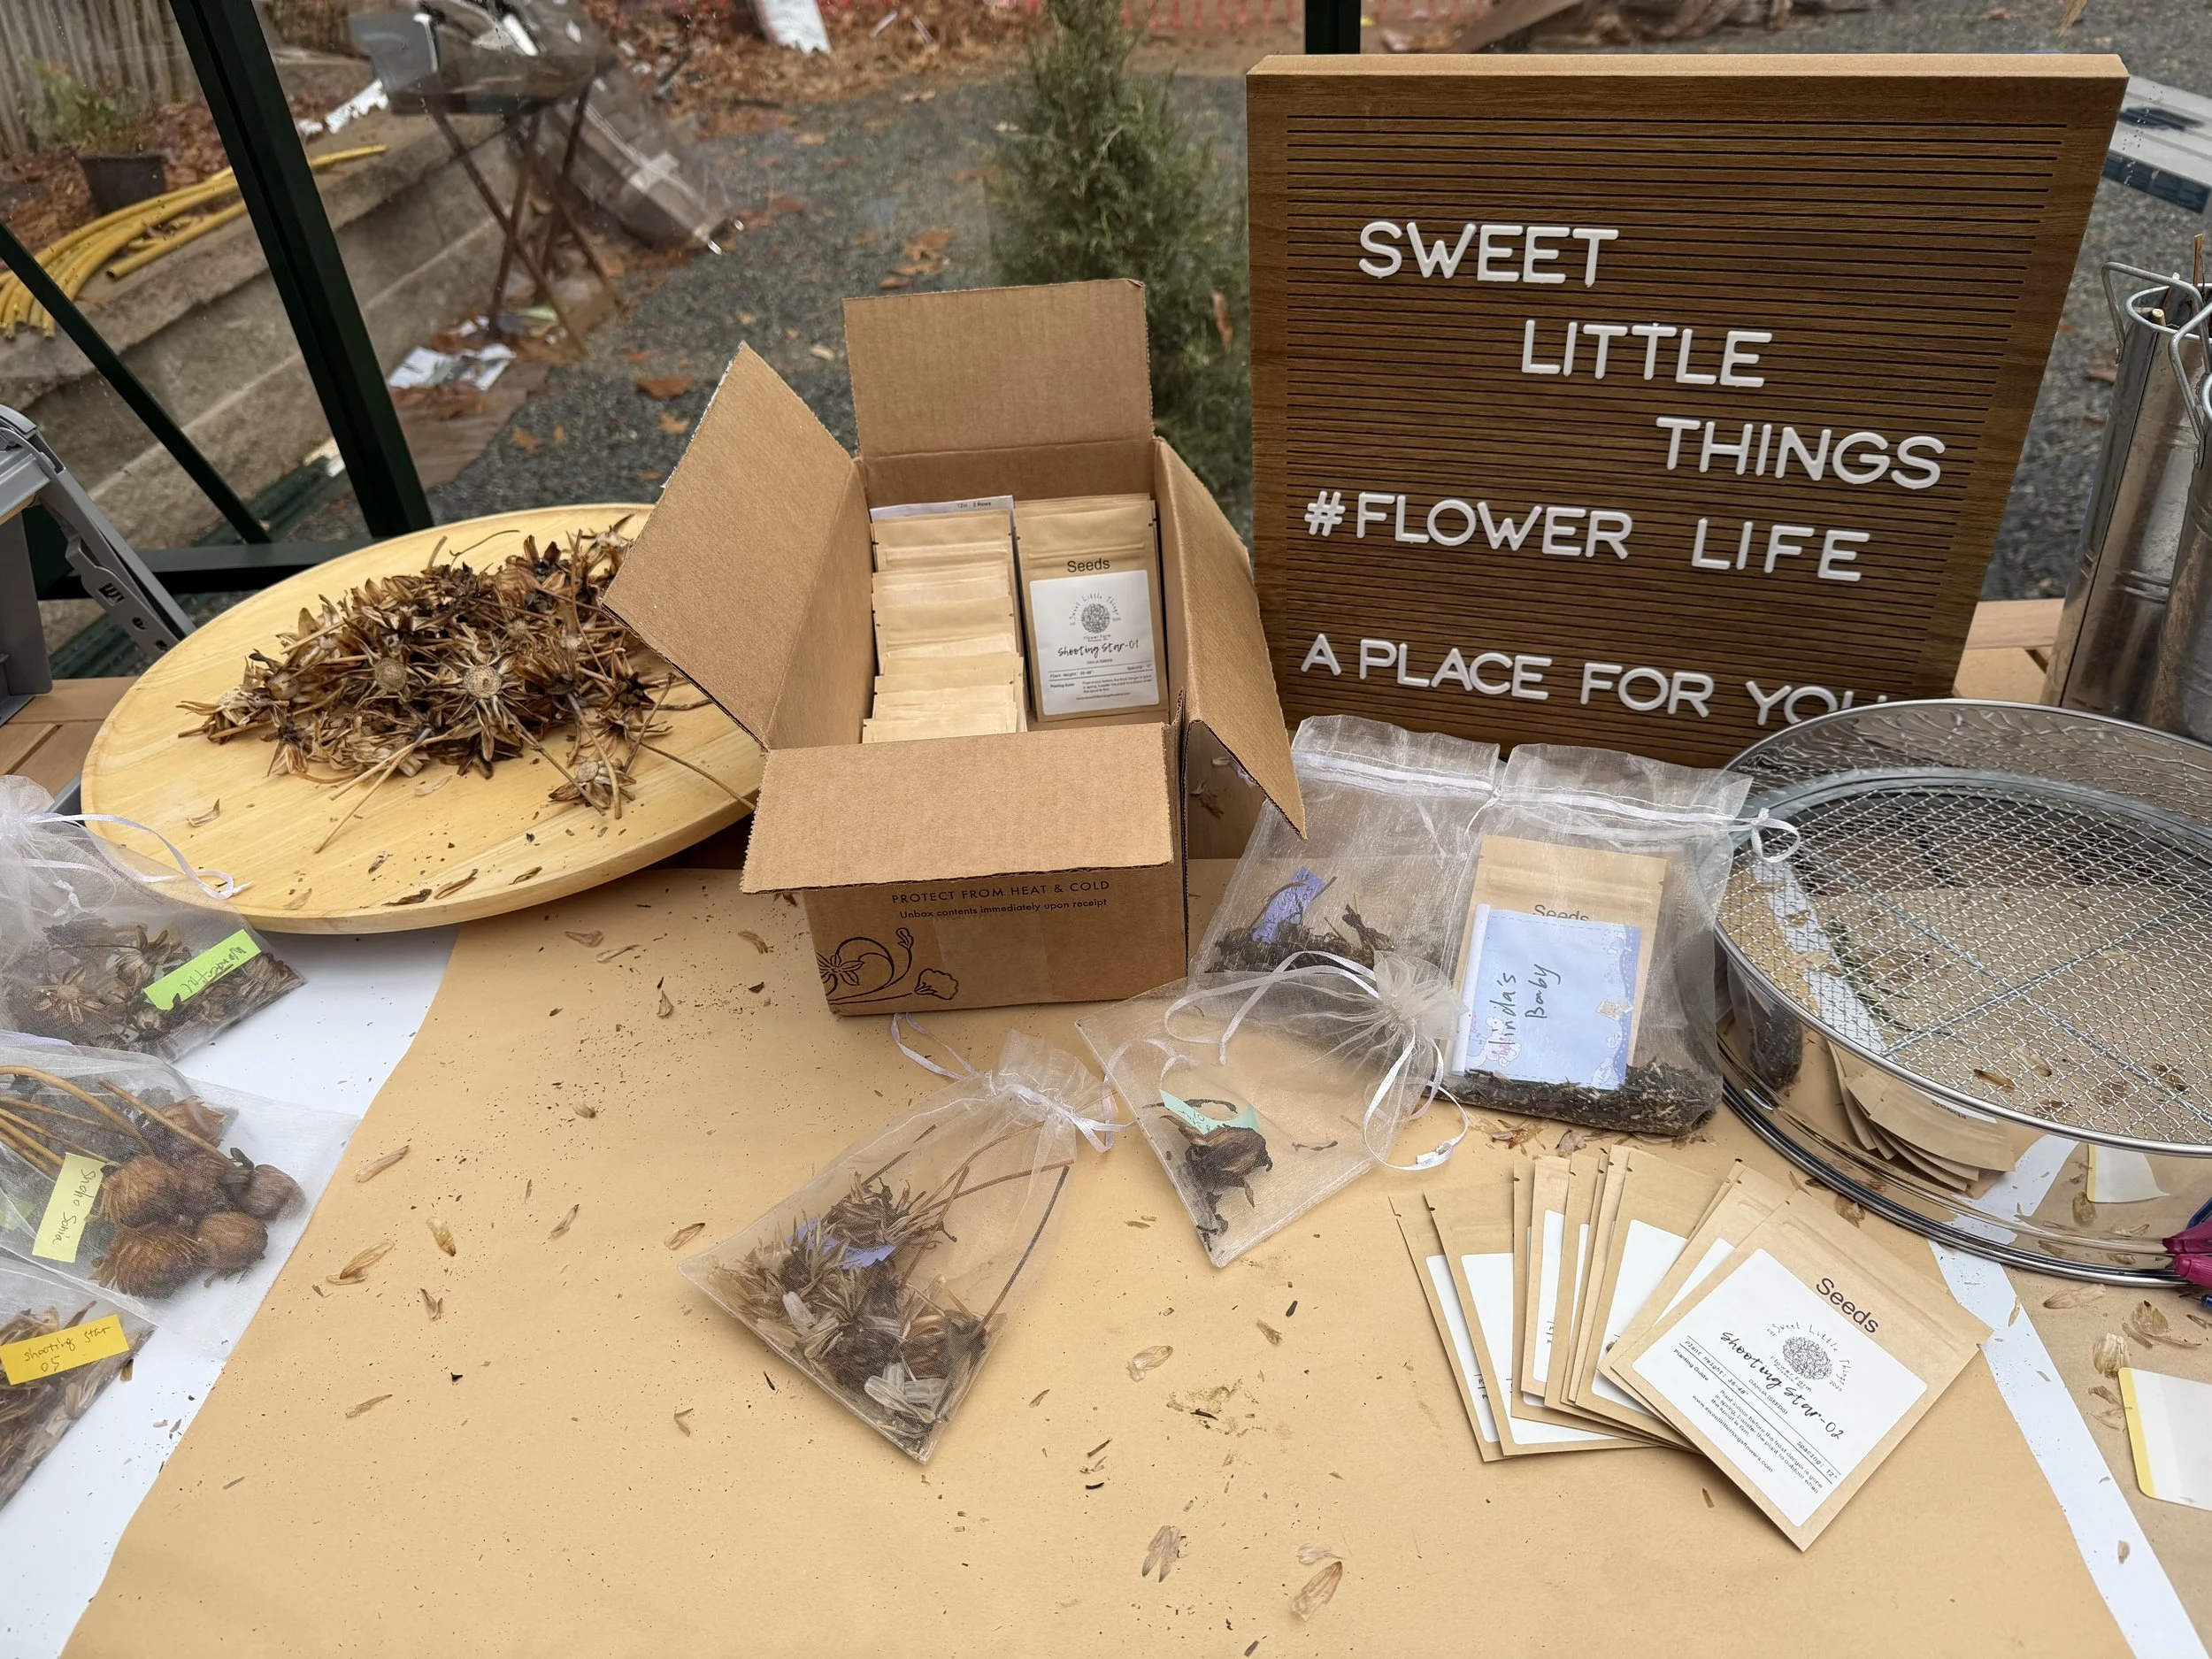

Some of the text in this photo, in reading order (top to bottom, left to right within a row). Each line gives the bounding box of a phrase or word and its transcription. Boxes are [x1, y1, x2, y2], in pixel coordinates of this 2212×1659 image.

[1358, 221, 1618, 287] SWEET
[1521, 319, 1772, 388] LITTLE
[1656, 417, 1945, 489] THINGS
[1304, 491, 1870, 582] #FLOWER LIFE
[1067, 557, 1110, 573] Seeds
[1057, 644, 1100, 658] Shooting
[1301, 634, 1341, 676] A
[1358, 638, 1553, 700] PLACE
[1580, 662, 1714, 717] FOR
[892, 880, 1110, 903] PROTECT FROM HEAT & COLD
[900, 898, 1107, 918] Unbox contents immediately upon receipt
[1525, 964, 1562, 1019] Baby
[52, 1211, 77, 1243] Sonia
[1816, 1278, 1878, 1333] Seeds
[1809, 1325, 1838, 1352] Little
[1673, 1348, 1709, 1381] Planting Guide
[1685, 1340, 1701, 1356] Plant
[1703, 1356, 1727, 1378] Height:
[1770, 1356, 1812, 1392] Flower Farm
[1720, 1332, 1844, 1440] Shooting Star-02
[1748, 1379, 1788, 1415] DAHLIA (SEEDS)
[1710, 1399, 1720, 1408] the
[1739, 1425, 1749, 1436] firm
[1720, 1389, 1733, 1402] Plant
[1732, 1402, 1748, 1417] indoor
[1747, 1416, 1765, 1433] before
[1765, 1432, 1774, 1441] the
[1774, 1440, 1787, 1454] frost
[1786, 1452, 1805, 1471] danger
[1809, 1474, 1823, 1488] gone
[1720, 1400, 1737, 1417] spring,
[1737, 1414, 1757, 1433] transfer
[1756, 1432, 1765, 1442] the
[1764, 1440, 1779, 1455] plant
[1784, 1458, 1805, 1479] outdoor
[1804, 1479, 1819, 1494] when
[1797, 1440, 1824, 1468] Spacing:
